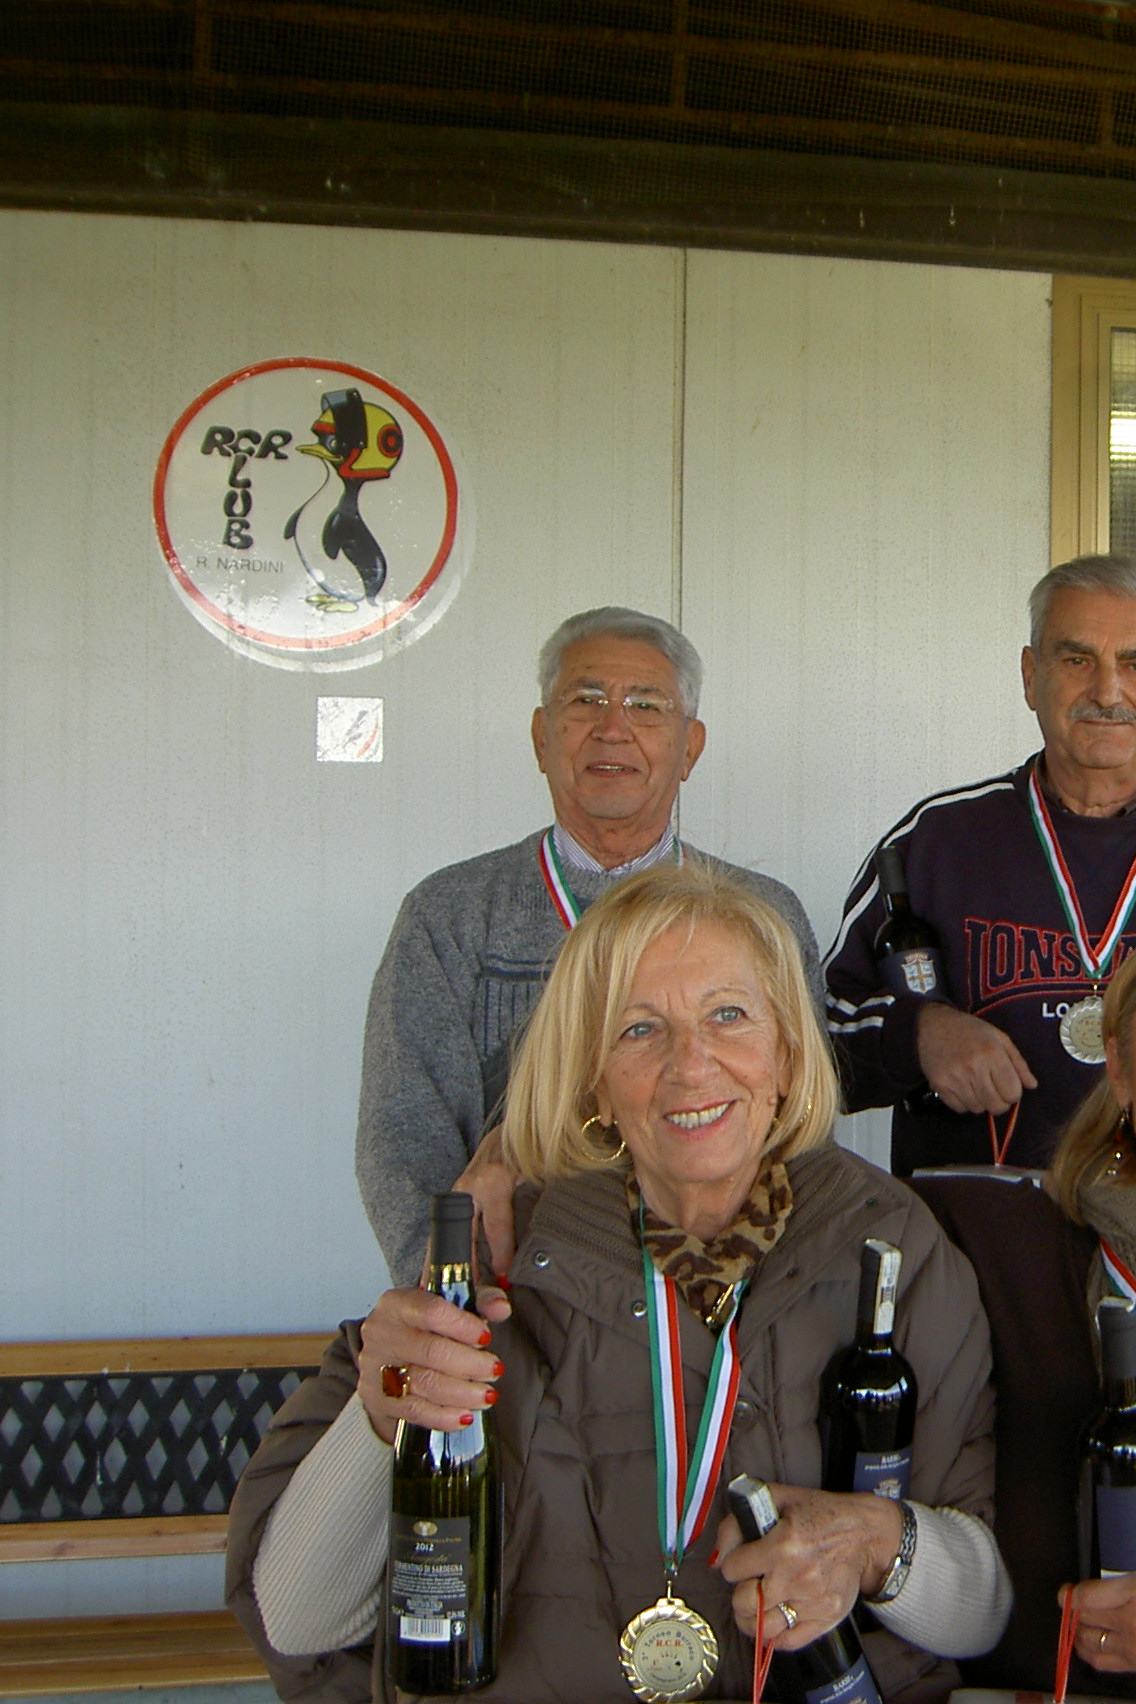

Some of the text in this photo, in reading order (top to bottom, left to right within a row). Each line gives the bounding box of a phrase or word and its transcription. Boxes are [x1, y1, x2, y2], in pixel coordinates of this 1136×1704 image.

[201, 425, 293, 460] RCR
[216, 557, 284, 573] NARDINI
[415, 1542, 434, 1552] 2012
